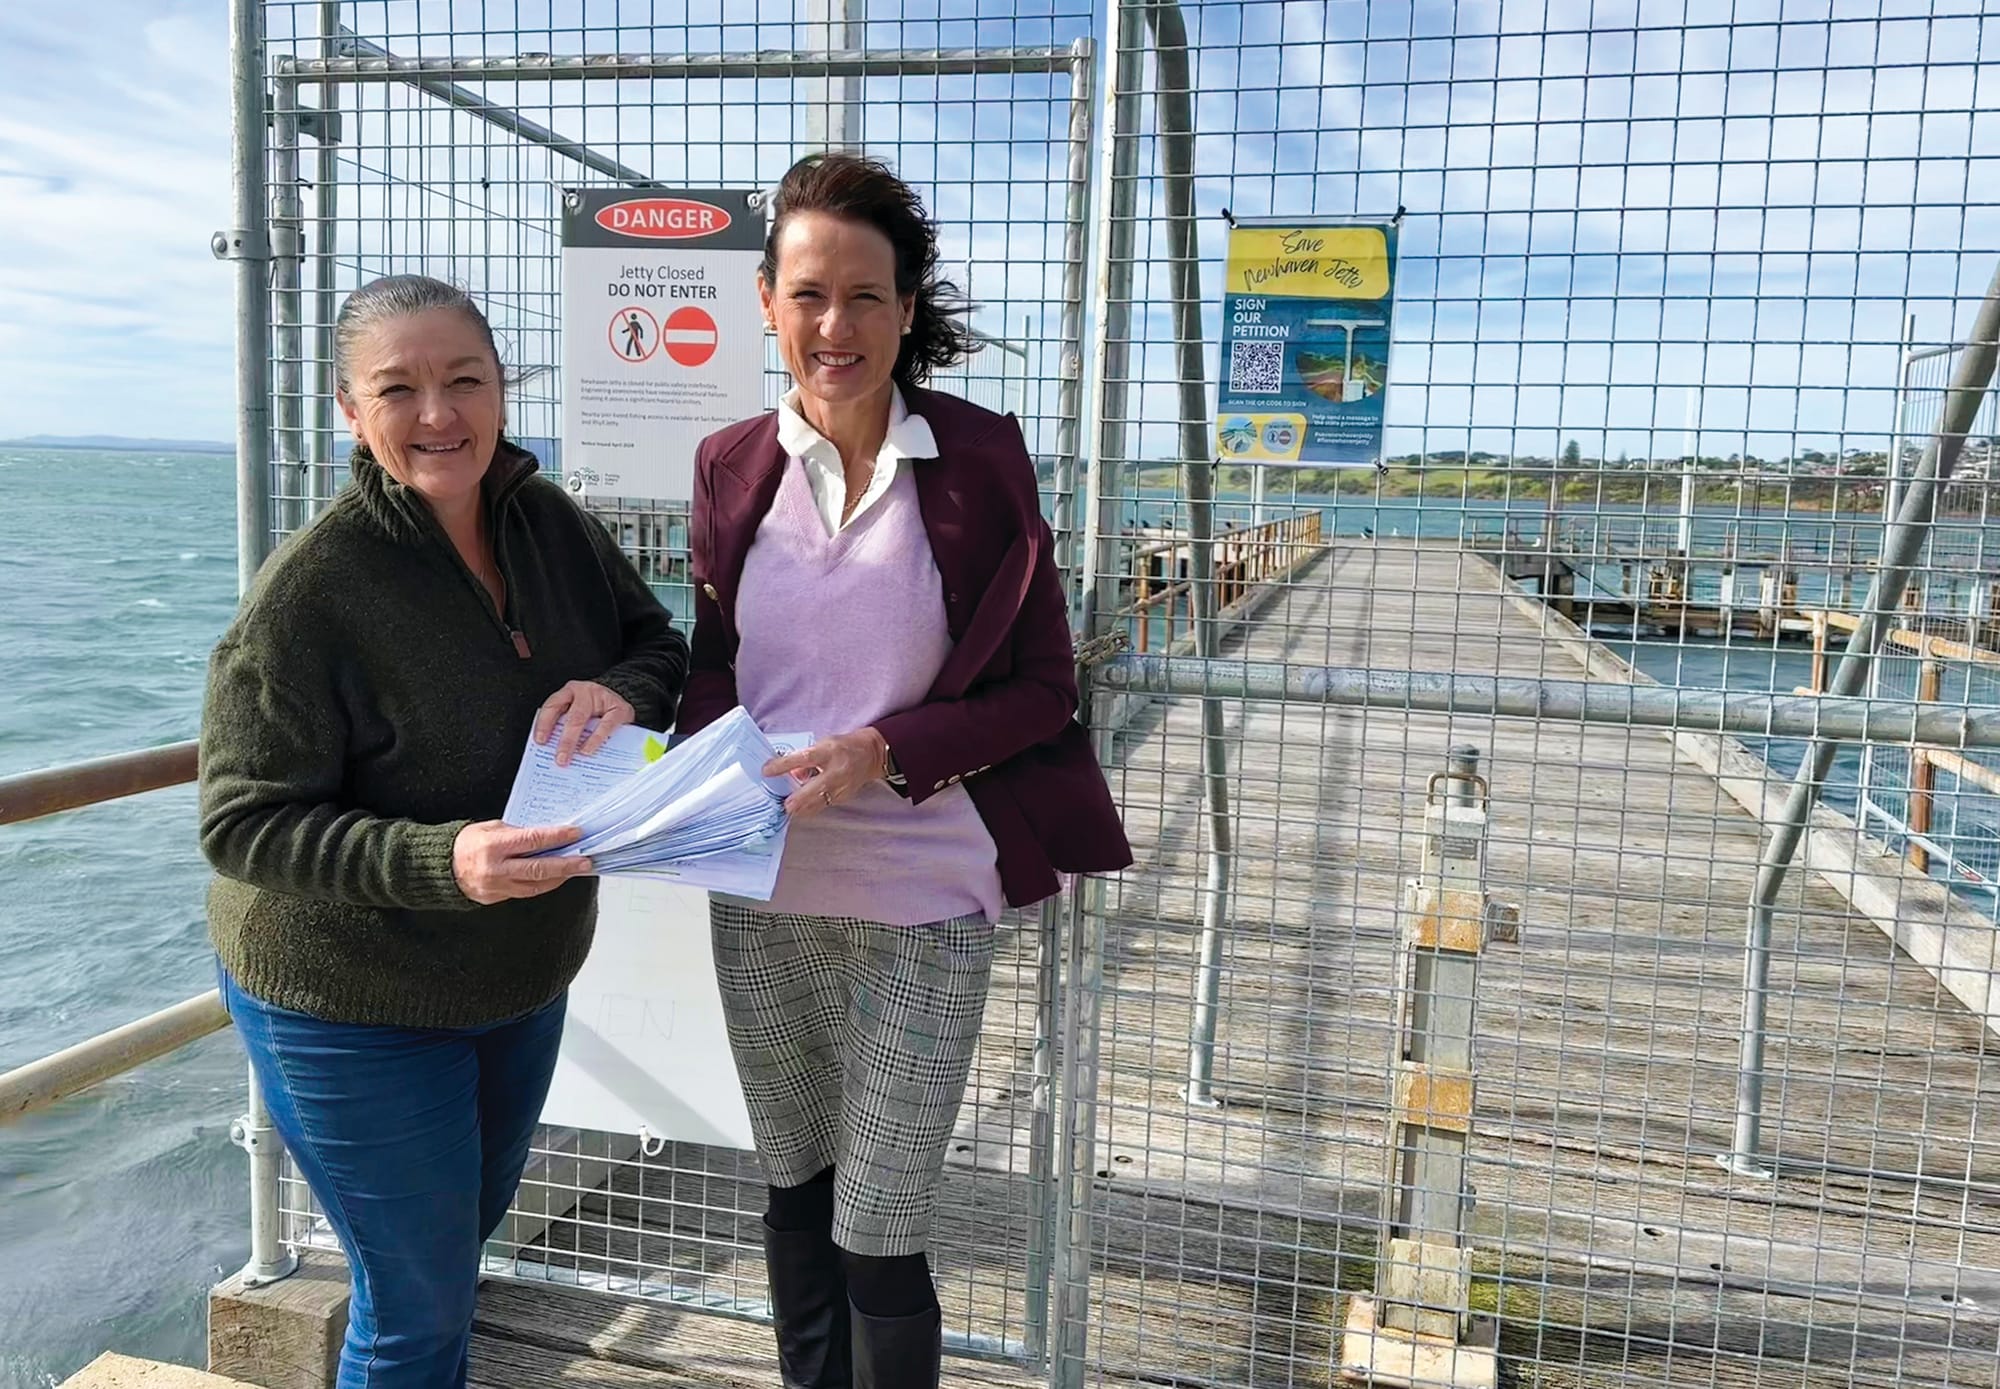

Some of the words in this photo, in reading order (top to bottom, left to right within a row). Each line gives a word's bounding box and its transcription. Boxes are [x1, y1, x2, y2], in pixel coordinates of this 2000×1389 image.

[612, 207, 714, 229] DANGER
[1279, 229, 1324, 255] Save
[619, 265, 654, 282] Jetty
[657, 265, 704, 280] Closed
[1243, 257, 1319, 291] Newhaven
[1323, 258, 1364, 289] Jetty
[608, 283, 630, 297] DO
[634, 284, 666, 298] NOT
[670, 285, 717, 299] ENTER
[1234, 298, 1266, 310] SIGN
[1233, 311, 1261, 324] OUR
[1232, 325, 1290, 337] PETITION
